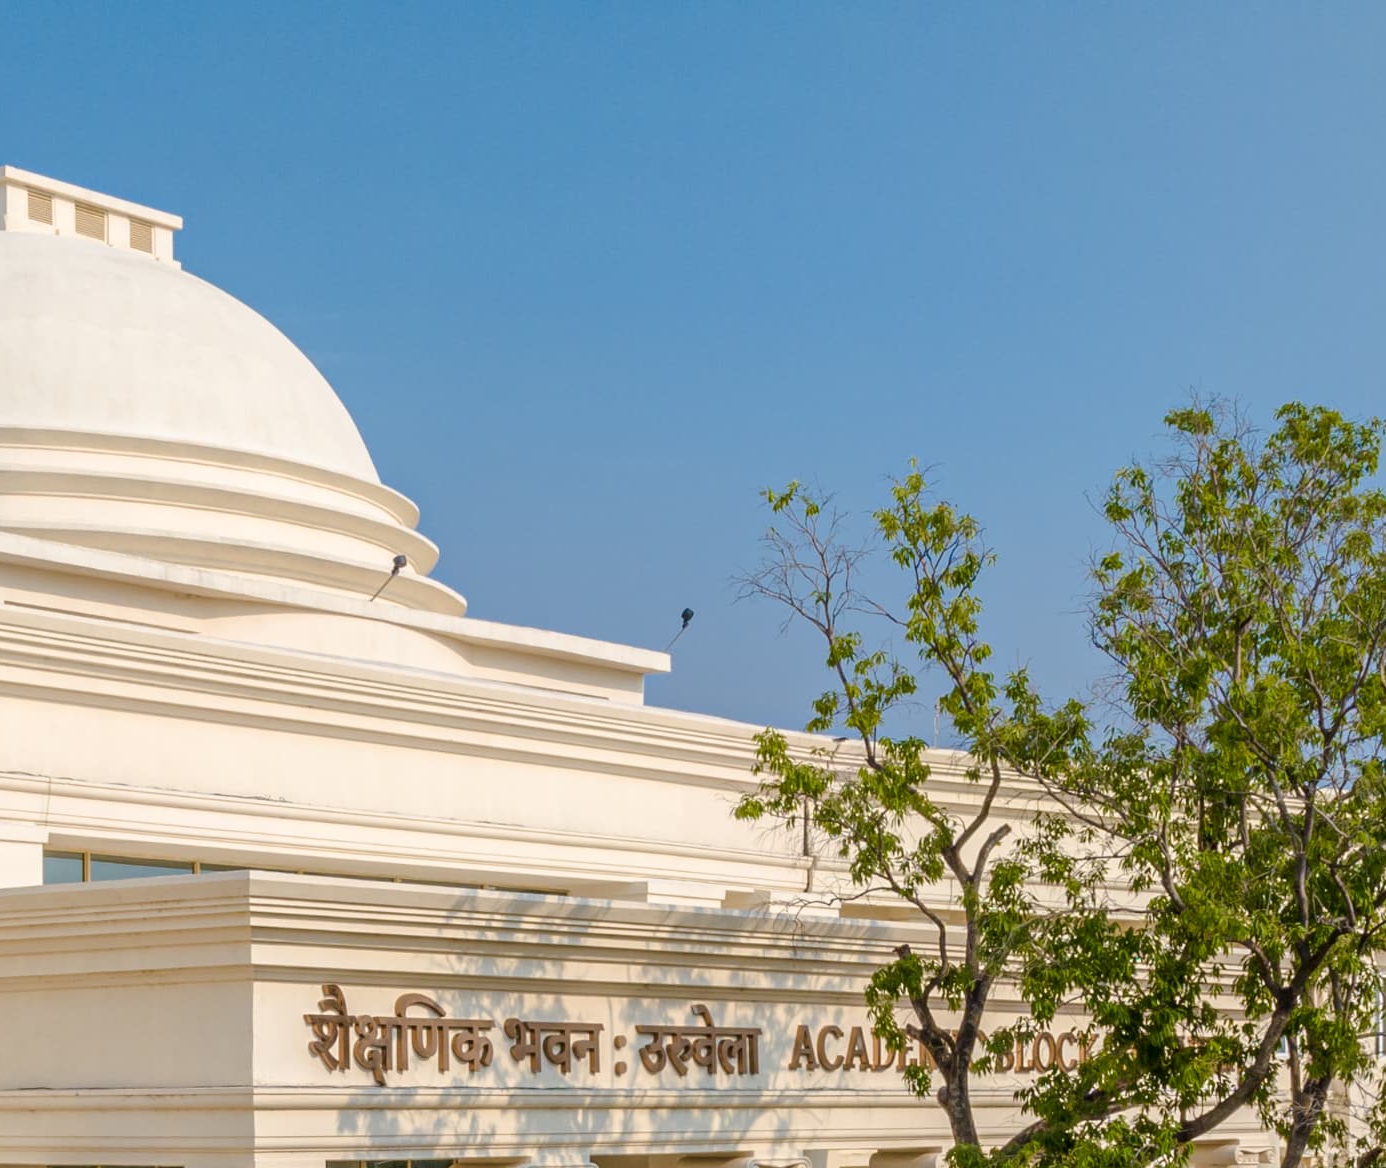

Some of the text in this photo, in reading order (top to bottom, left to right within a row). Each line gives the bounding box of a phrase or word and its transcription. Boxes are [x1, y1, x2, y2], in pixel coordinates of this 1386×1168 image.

[303, 983, 495, 1087] शैक्षणिक
[503, 1017, 605, 1075] भवन
[635, 1003, 763, 1078] उरुवेला
